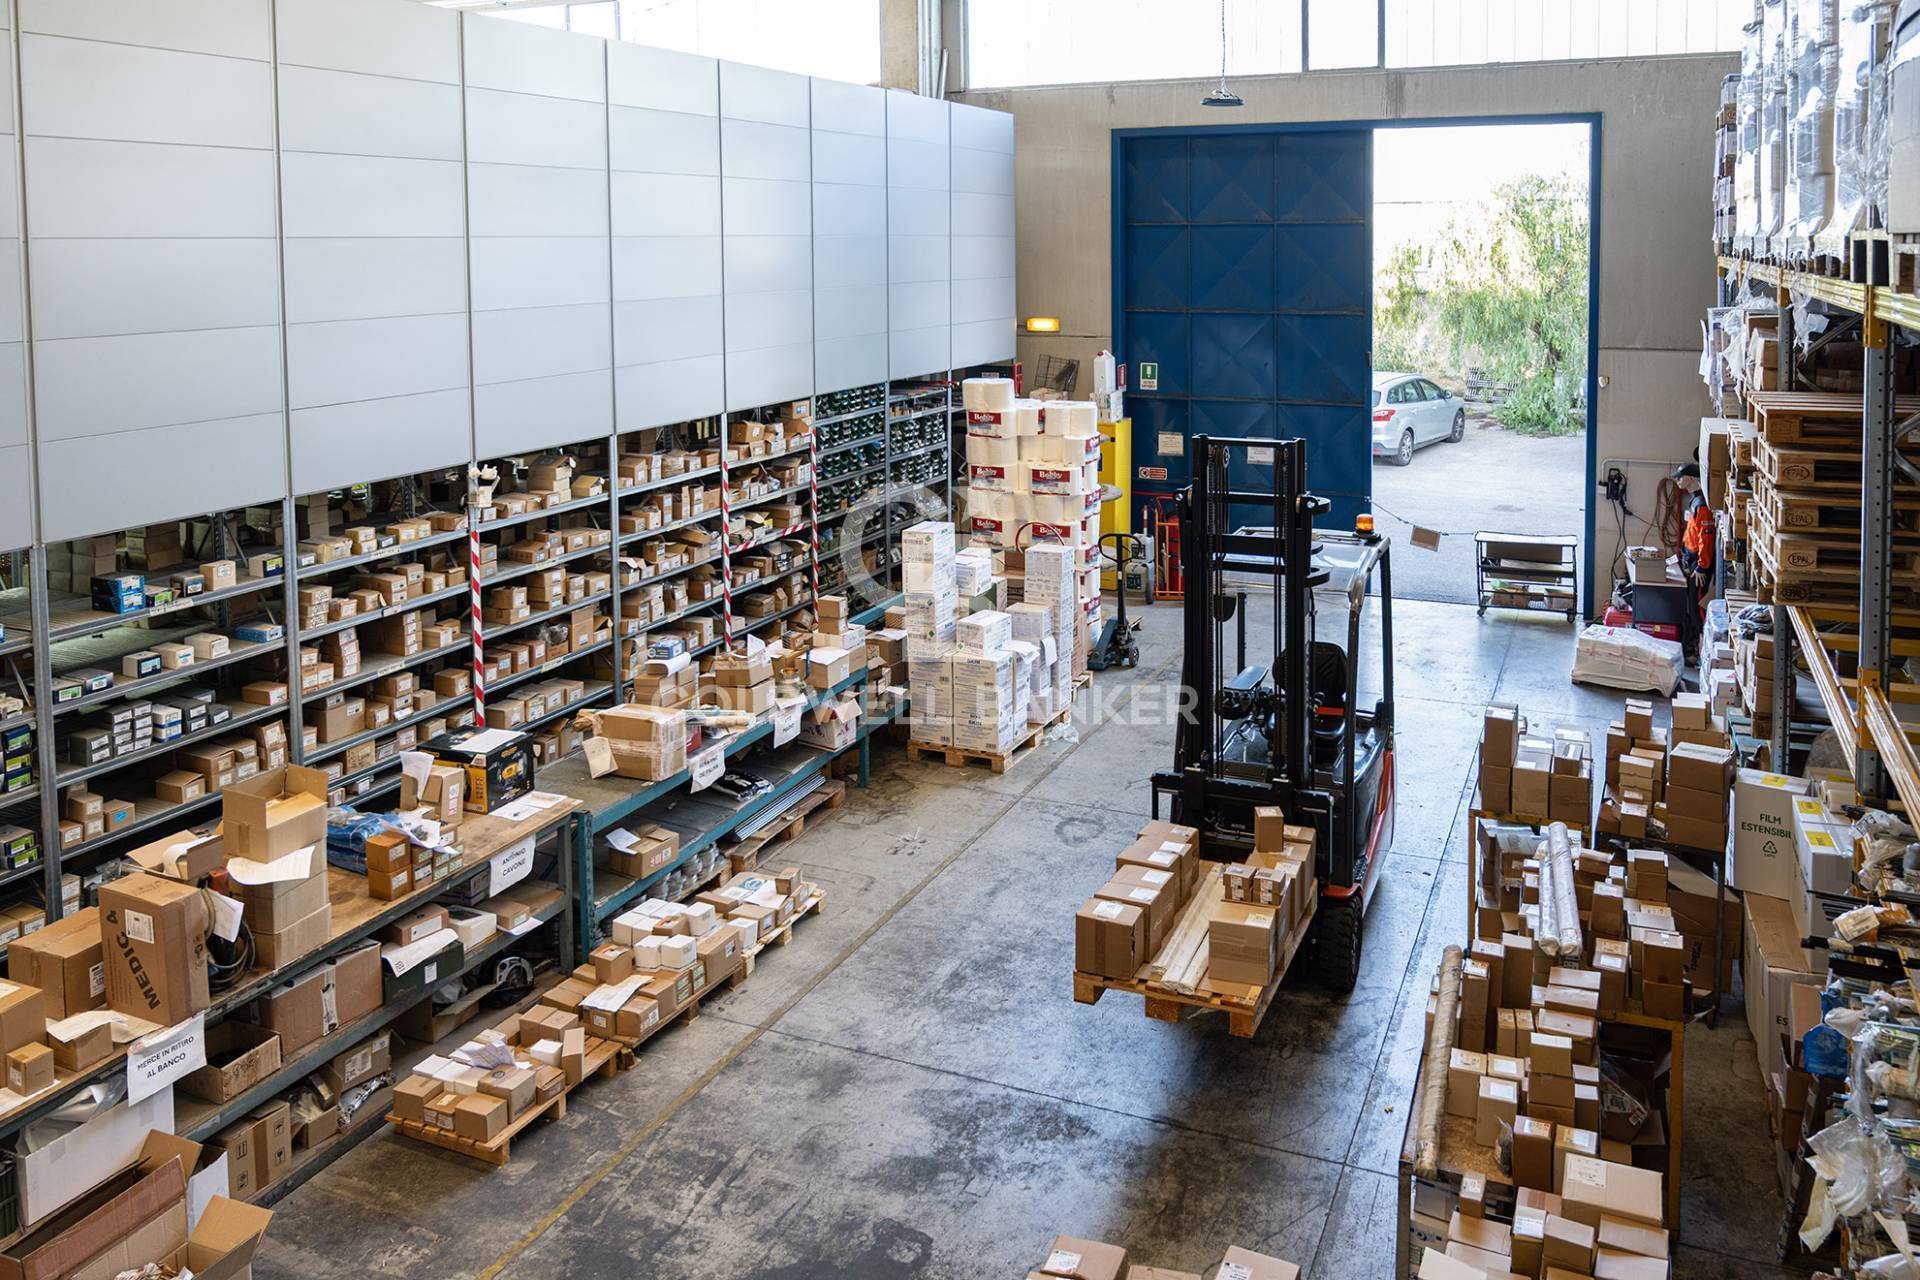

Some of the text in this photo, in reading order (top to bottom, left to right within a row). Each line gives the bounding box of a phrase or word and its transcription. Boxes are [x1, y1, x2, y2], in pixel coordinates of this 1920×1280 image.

[1741, 821, 1792, 839] ESTENSIBIL
[1760, 813, 1782, 825] FILM
[116, 931, 161, 1011] MEDIC
[137, 1036, 194, 1070] MERCE IN RITIRO
[147, 1052, 186, 1078] AL BANCO
